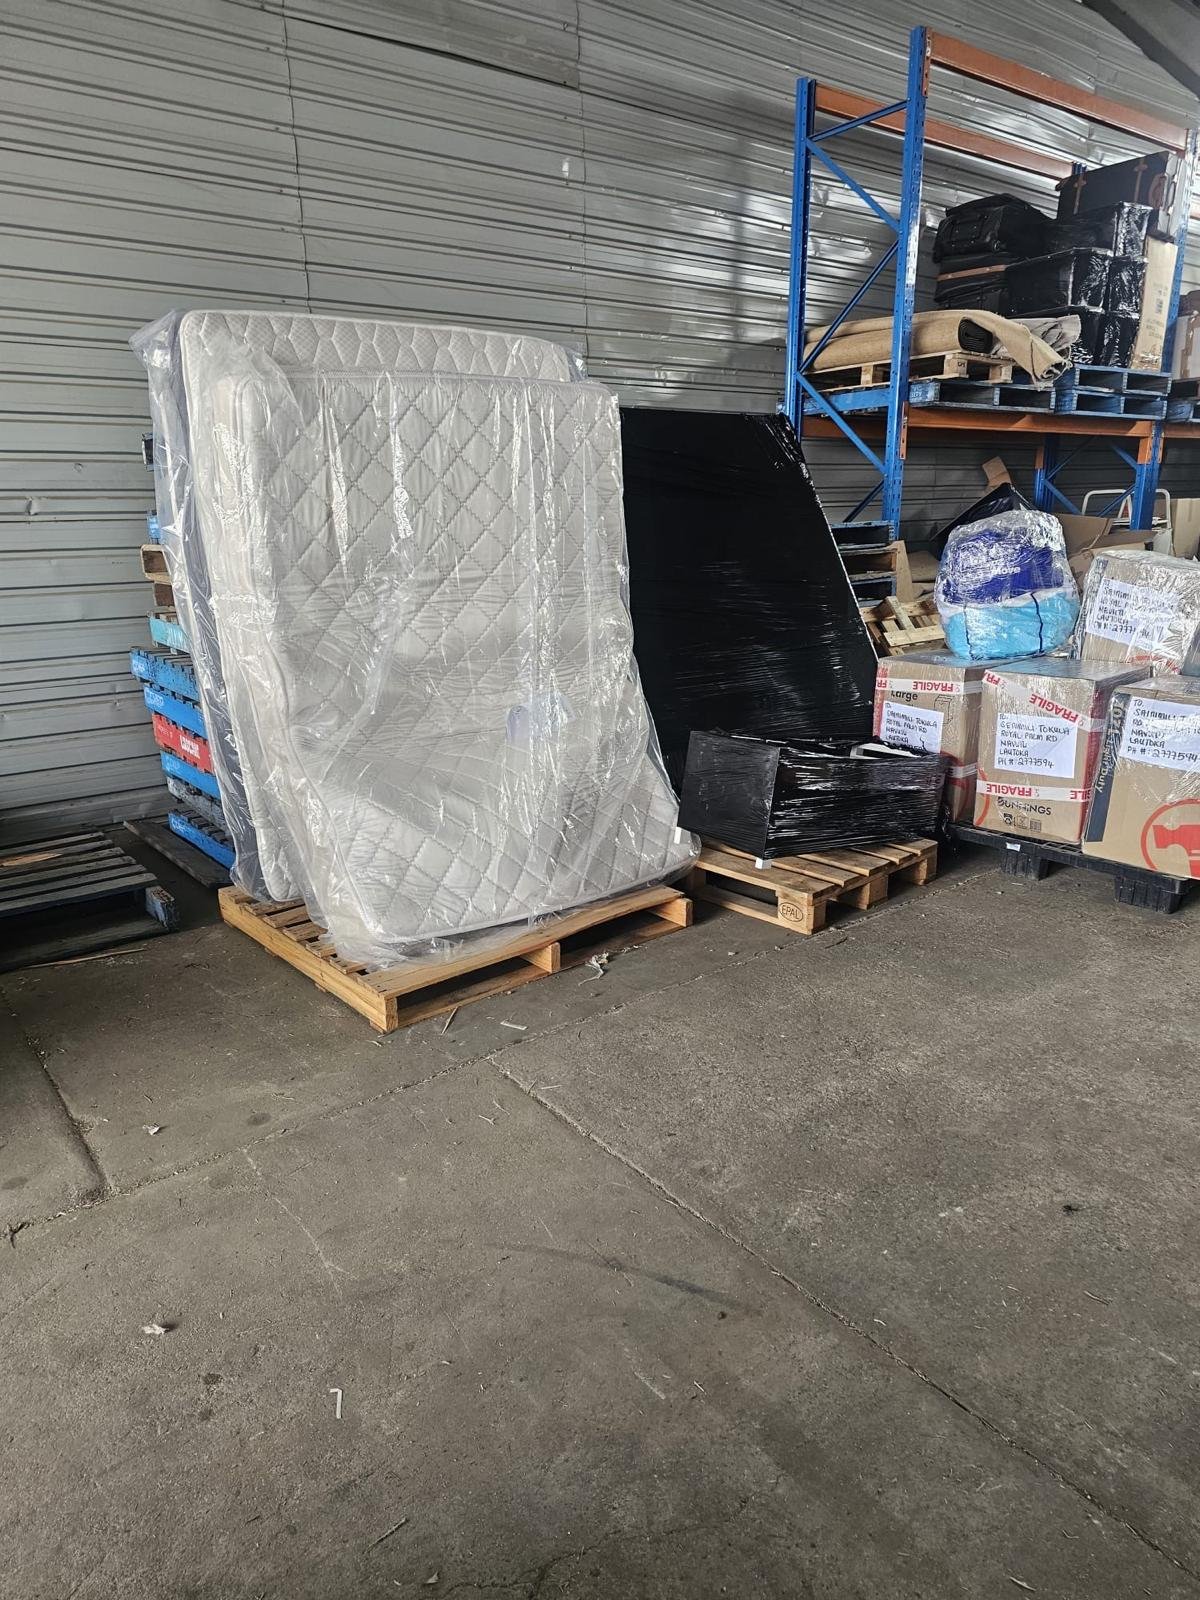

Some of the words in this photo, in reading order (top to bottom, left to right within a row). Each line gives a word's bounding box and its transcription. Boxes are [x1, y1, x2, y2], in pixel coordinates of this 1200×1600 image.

[912, 681, 954, 692] FRAGILE
[1029, 694, 1080, 723] FRAGILE
[1046, 734, 1058, 742] RD
[1095, 766, 1109, 793] Duty
[986, 783, 1032, 797] FRAGILE
[782, 906, 802, 921] EPAL
